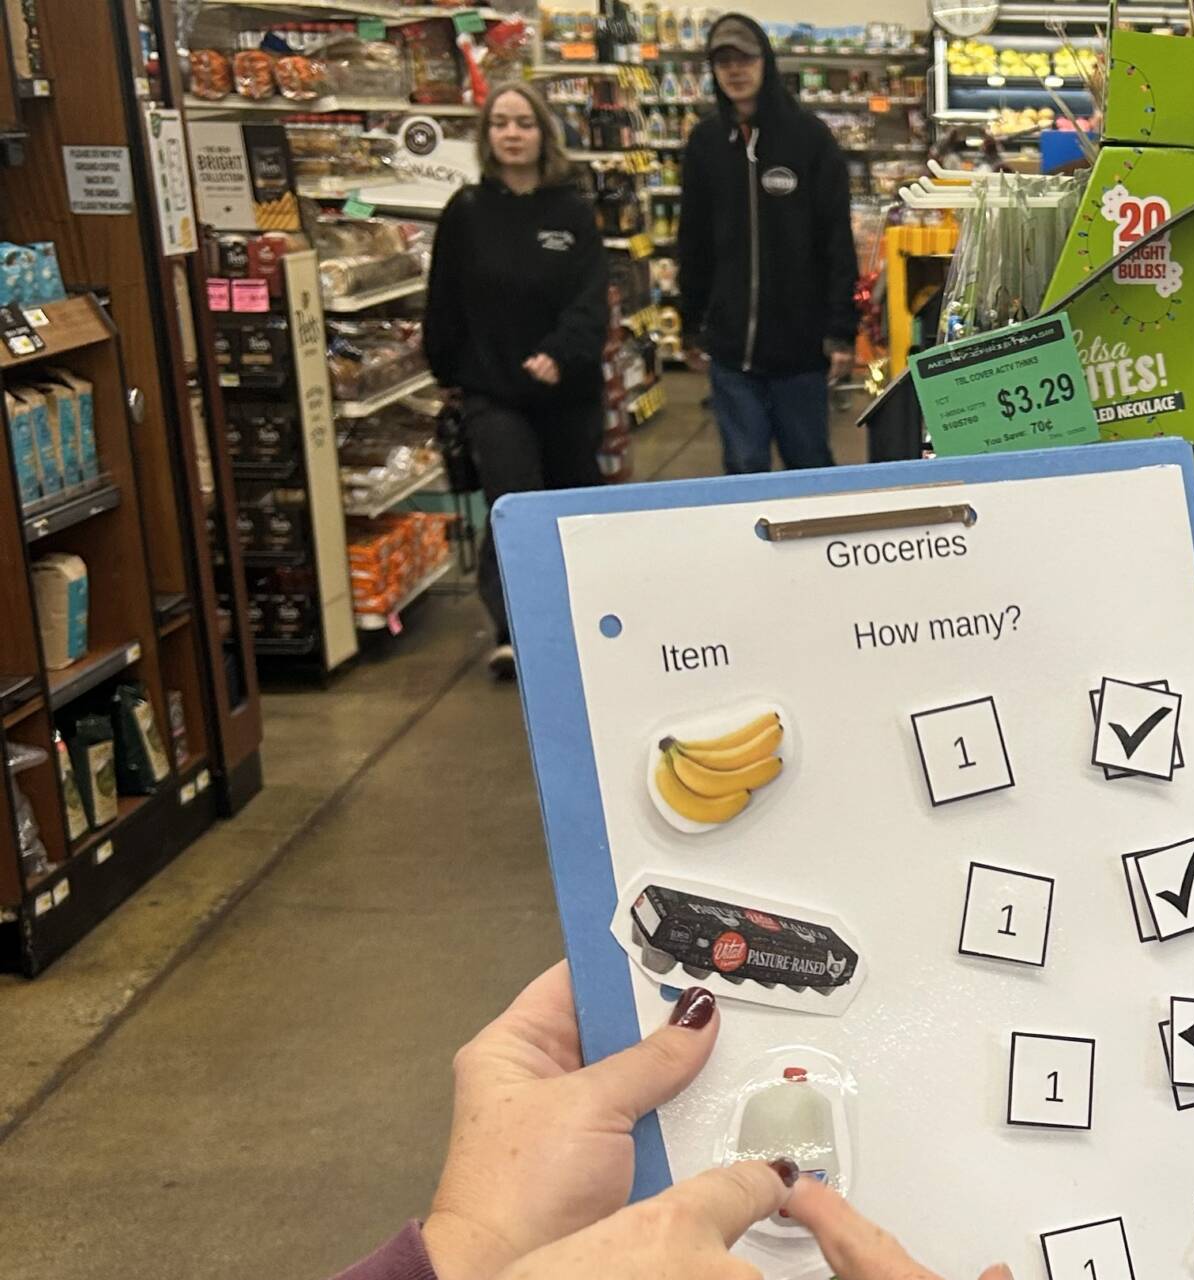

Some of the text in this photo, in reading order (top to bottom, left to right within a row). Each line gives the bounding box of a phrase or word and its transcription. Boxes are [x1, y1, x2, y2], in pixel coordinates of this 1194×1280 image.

[197, 154, 243, 171] BRIGHT
[1118, 201, 1167, 243] 20
[1118, 245, 1167, 261] IGHT
[1118, 263, 1167, 279] BULBS!
[969, 367, 995, 383] COVER
[1084, 352, 1168, 402] ITES!
[996, 372, 1076, 422] $3.29
[1093, 395, 1177, 422] LED NECKLACE
[1029, 418, 1054, 435] 70¢
[826, 530, 968, 568] Groceries
[853, 604, 1022, 650] How many?
[661, 642, 730, 673] Item
[953, 736, 977, 769] 1
[997, 904, 1017, 937] 1
[714, 938, 748, 961] Vital
[748, 948, 827, 976] PASTURE-RAISED
[1044, 1070, 1064, 1103] 1
